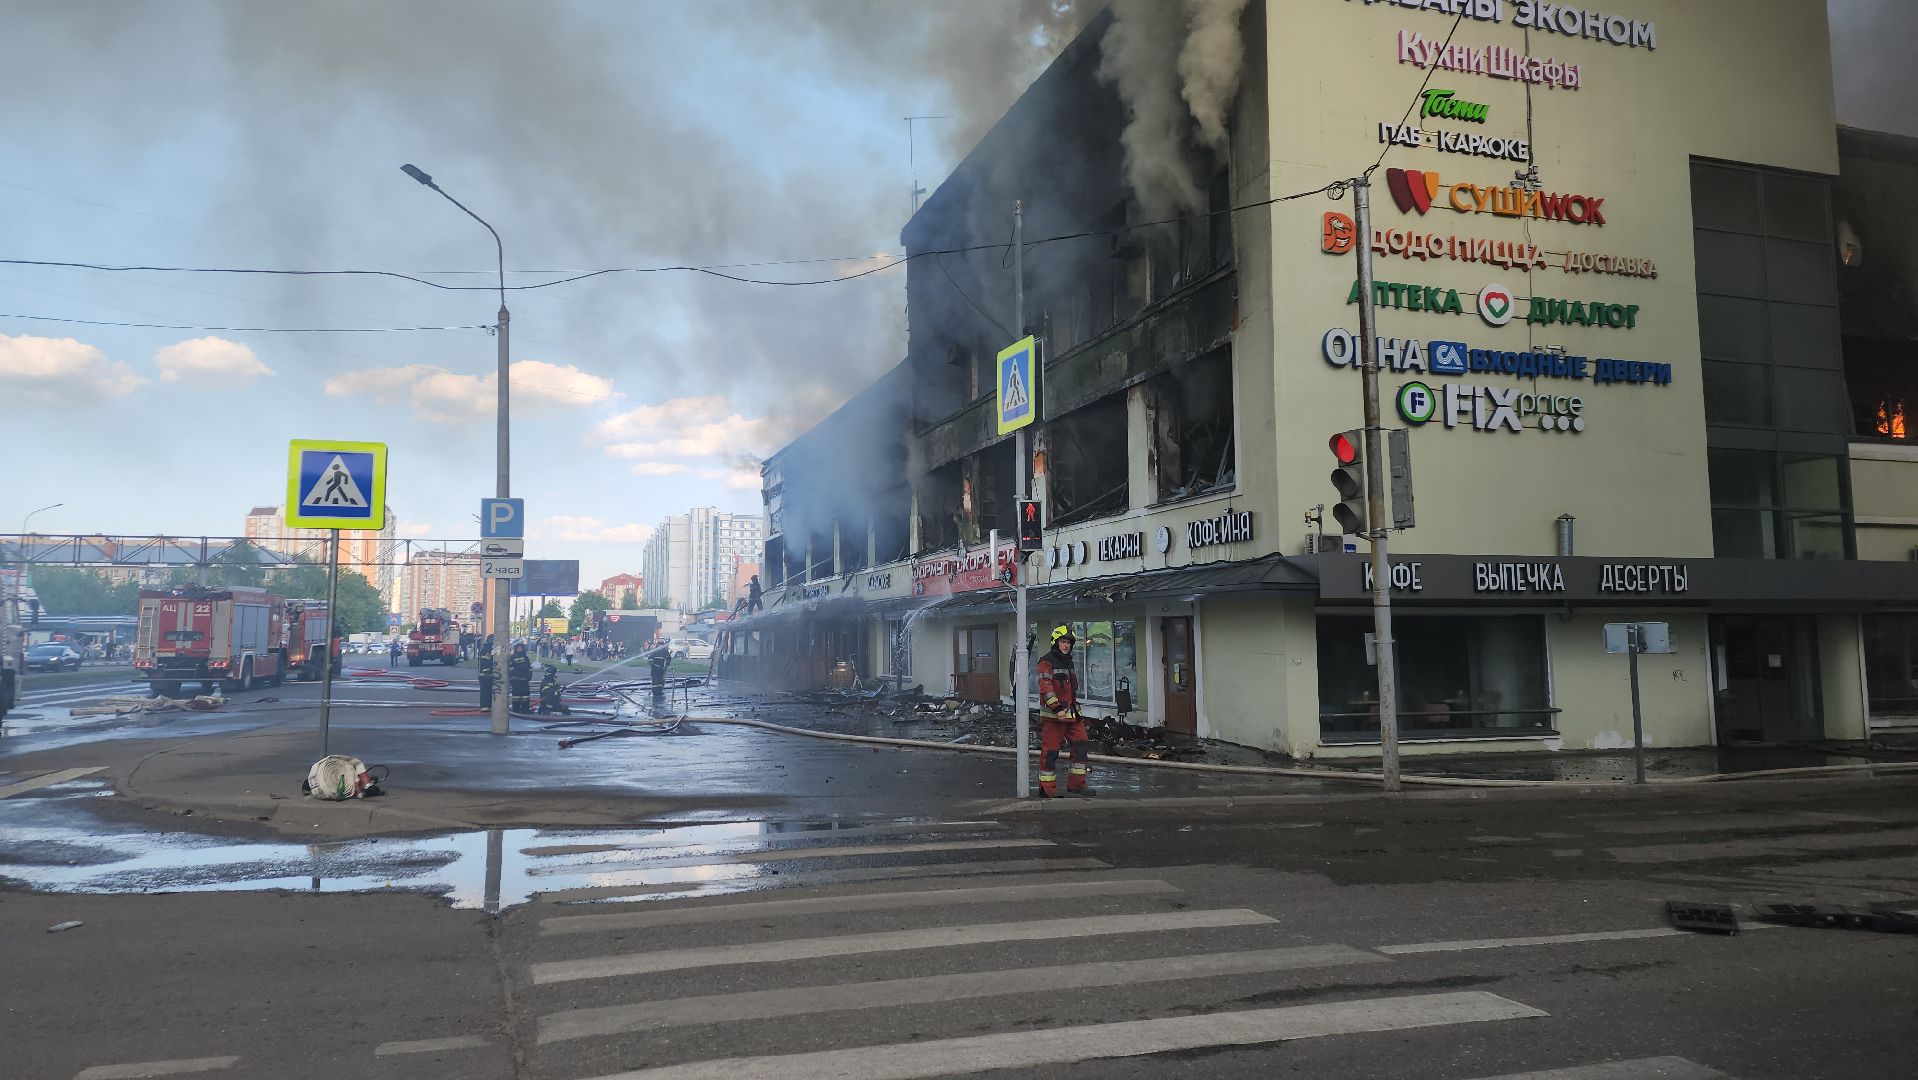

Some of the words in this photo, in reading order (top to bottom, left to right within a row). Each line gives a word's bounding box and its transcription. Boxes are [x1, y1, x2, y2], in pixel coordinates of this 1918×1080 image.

[1513, 0, 1657, 49] ЭКОНОМ
[1438, 131, 1530, 162] КАРАОКЕ
[1564, 251, 1659, 279] ДОСТАВКА
[1527, 297, 1640, 329] ДИАЛОГ
[1469, 348, 1589, 380] ВХОДНЫЕ
[1594, 357, 1672, 387] ДВЕРИ
[1186, 510, 1254, 549] КОФЕЙНЯ
[485, 563, 493, 574] 2
[495, 566, 520, 574] часа
[1362, 562, 1423, 591] КФЕ
[1474, 563, 1566, 592] ВЫПЕЧКА
[1600, 564, 1689, 592] ДЕСЕРТЫ
[162, 604, 177, 613] АЦ
[195, 604, 210, 613] 22
